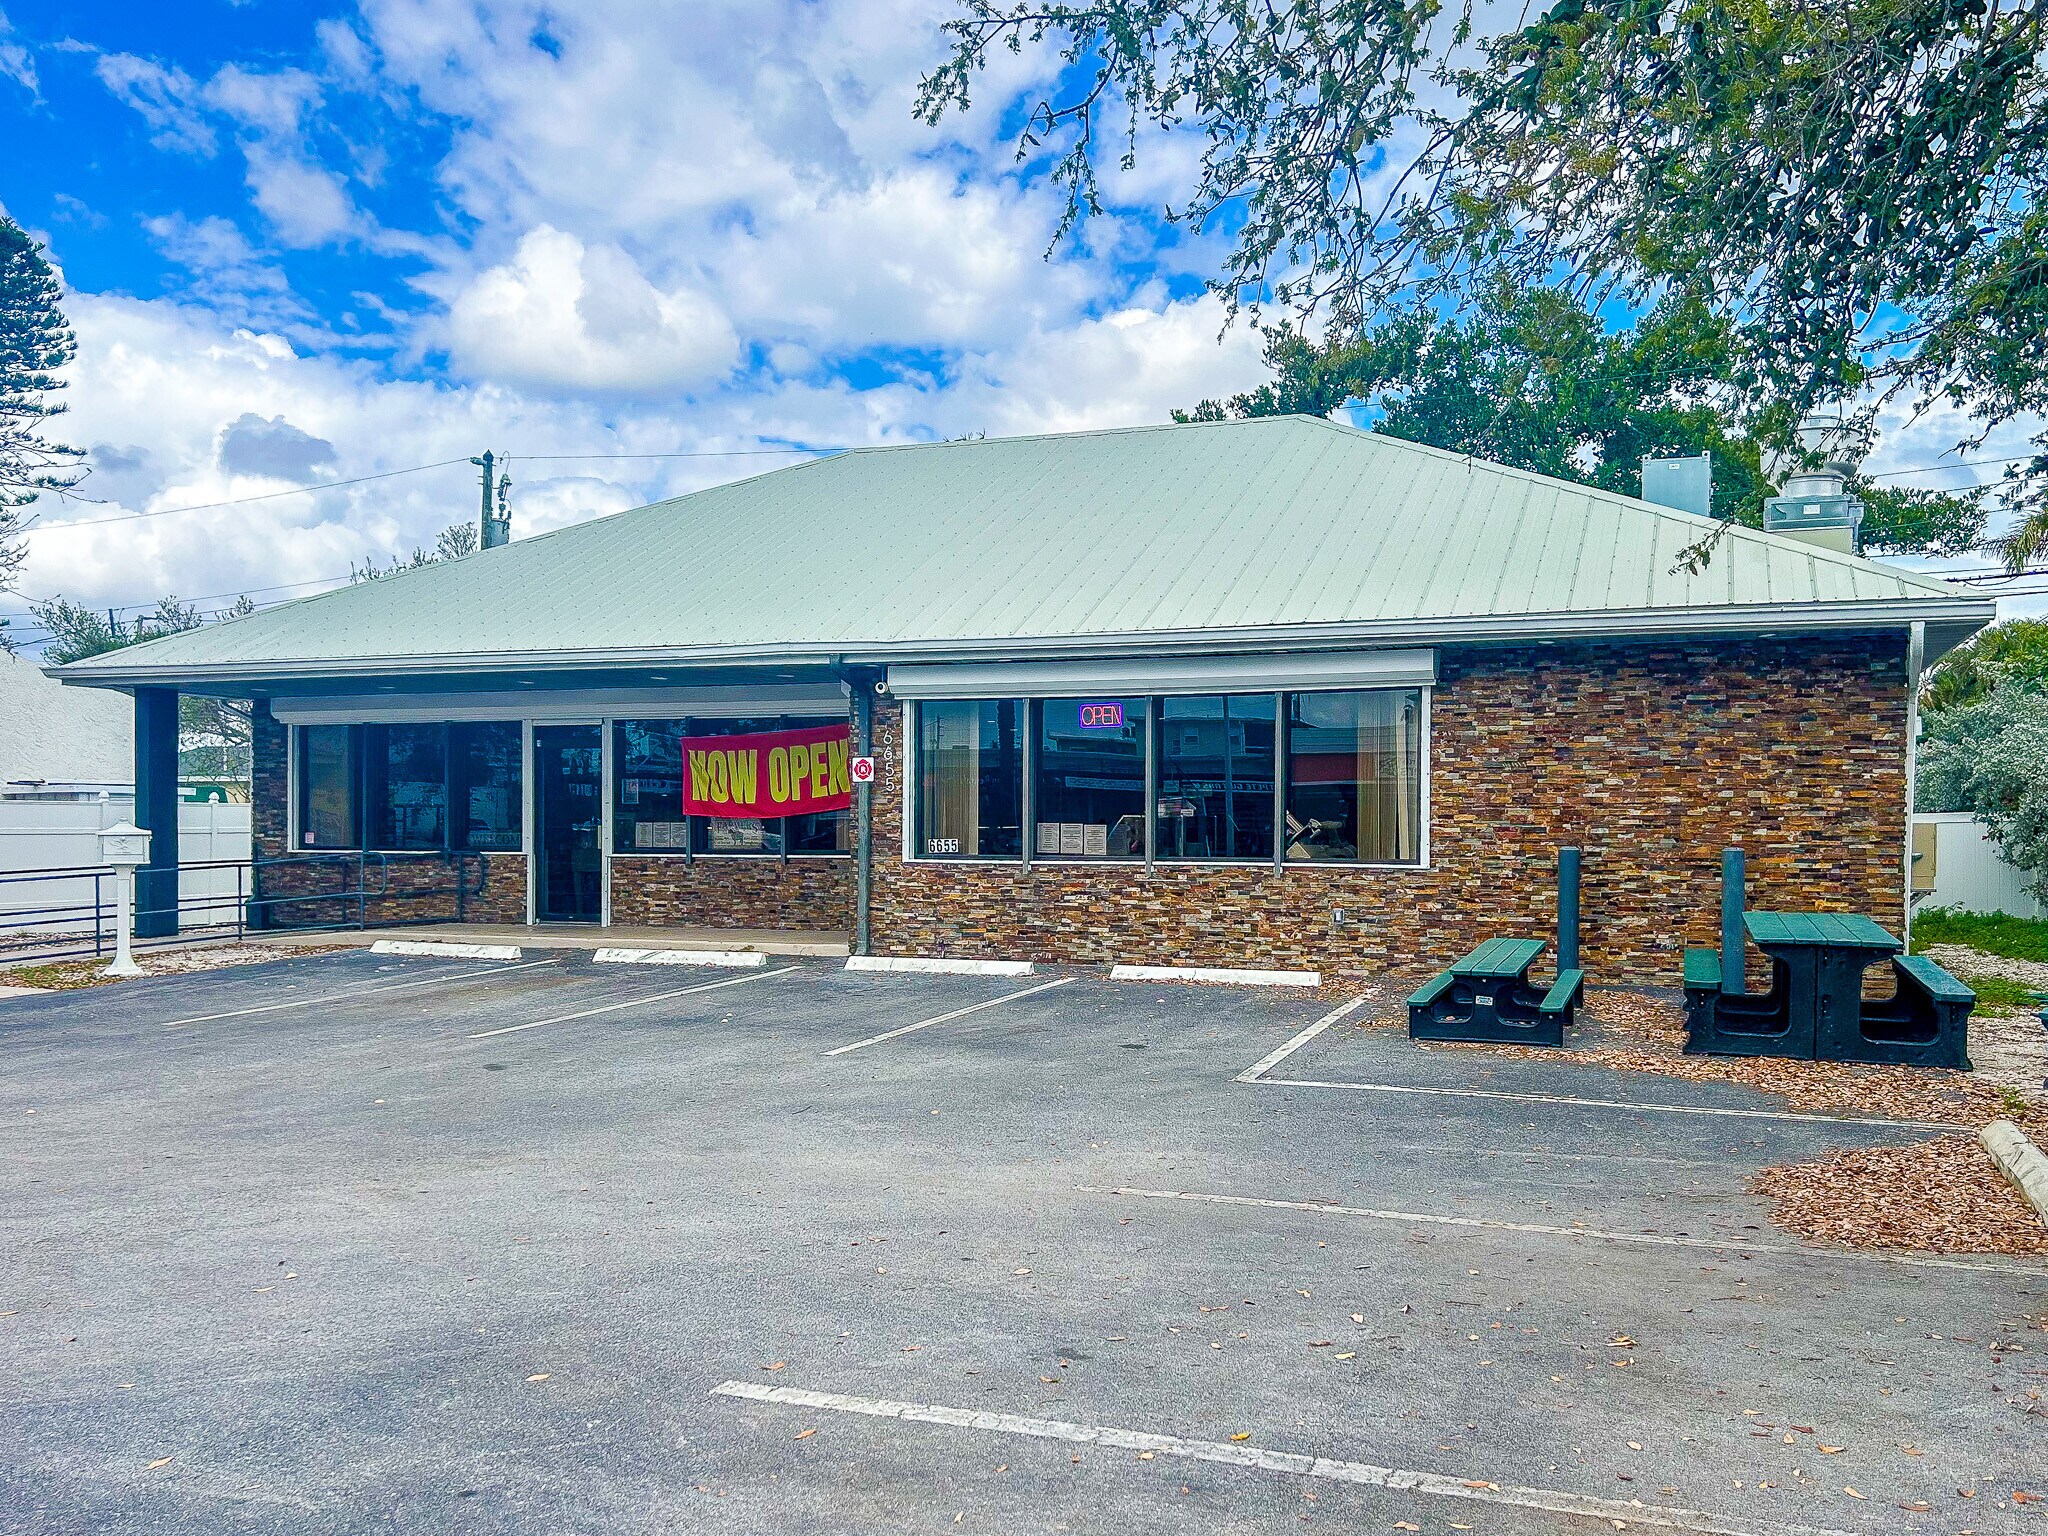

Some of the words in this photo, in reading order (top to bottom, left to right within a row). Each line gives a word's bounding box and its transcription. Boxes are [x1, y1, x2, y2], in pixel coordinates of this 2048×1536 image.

[1081, 705, 1121, 726] OPEN
[689, 749, 758, 804] NOW
[768, 738, 850, 803] OPEN
[883, 730, 895, 792] 6655
[929, 839, 958, 853] 6655
